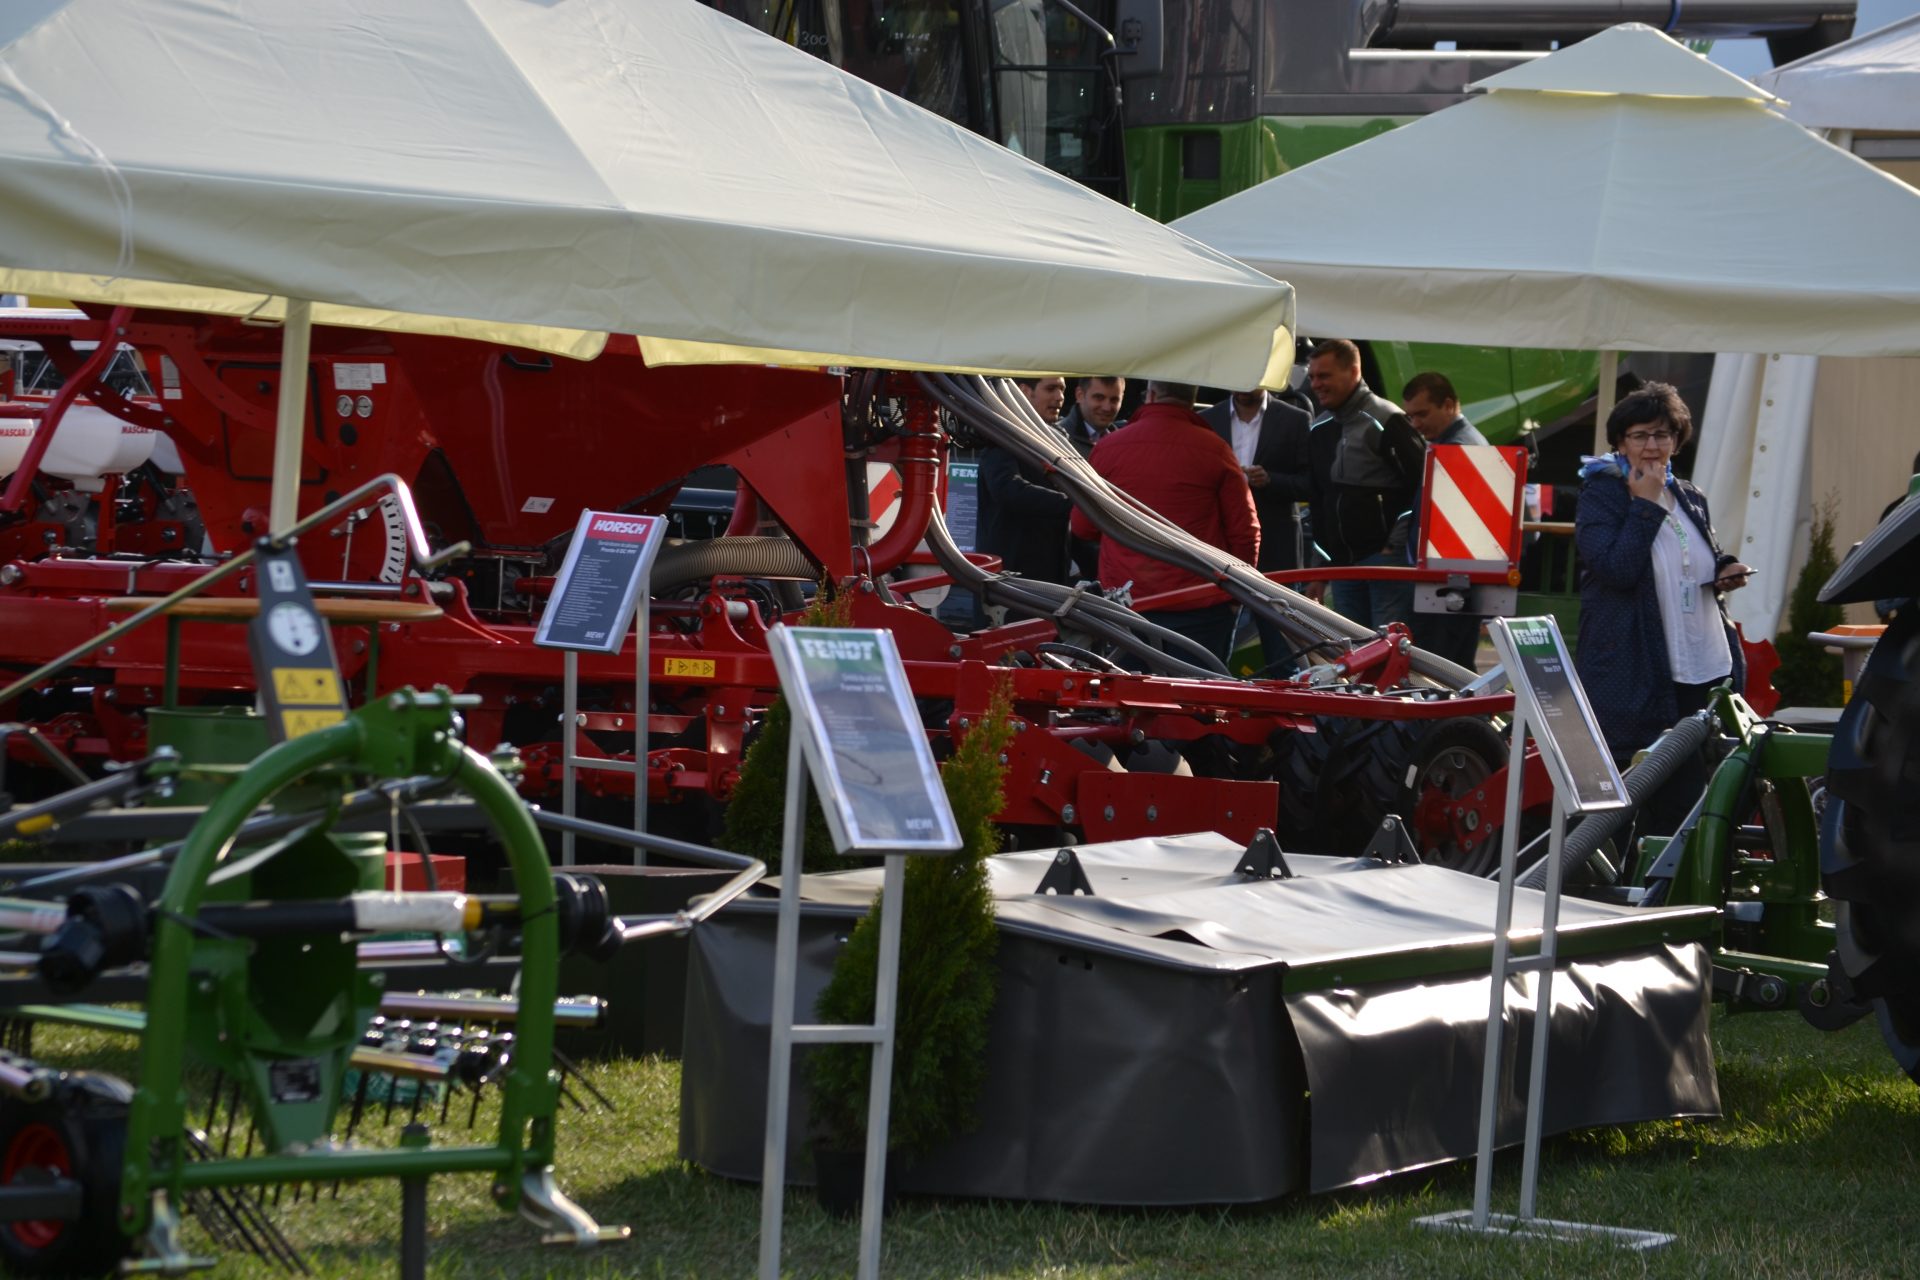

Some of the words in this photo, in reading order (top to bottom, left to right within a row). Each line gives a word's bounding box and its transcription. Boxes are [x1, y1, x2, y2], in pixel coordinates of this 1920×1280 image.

[952, 468, 978, 478] FEN
[593, 520, 647, 534] HORSCH
[1512, 628, 1550, 645] FENDT
[800, 638, 874, 660] FENDT
